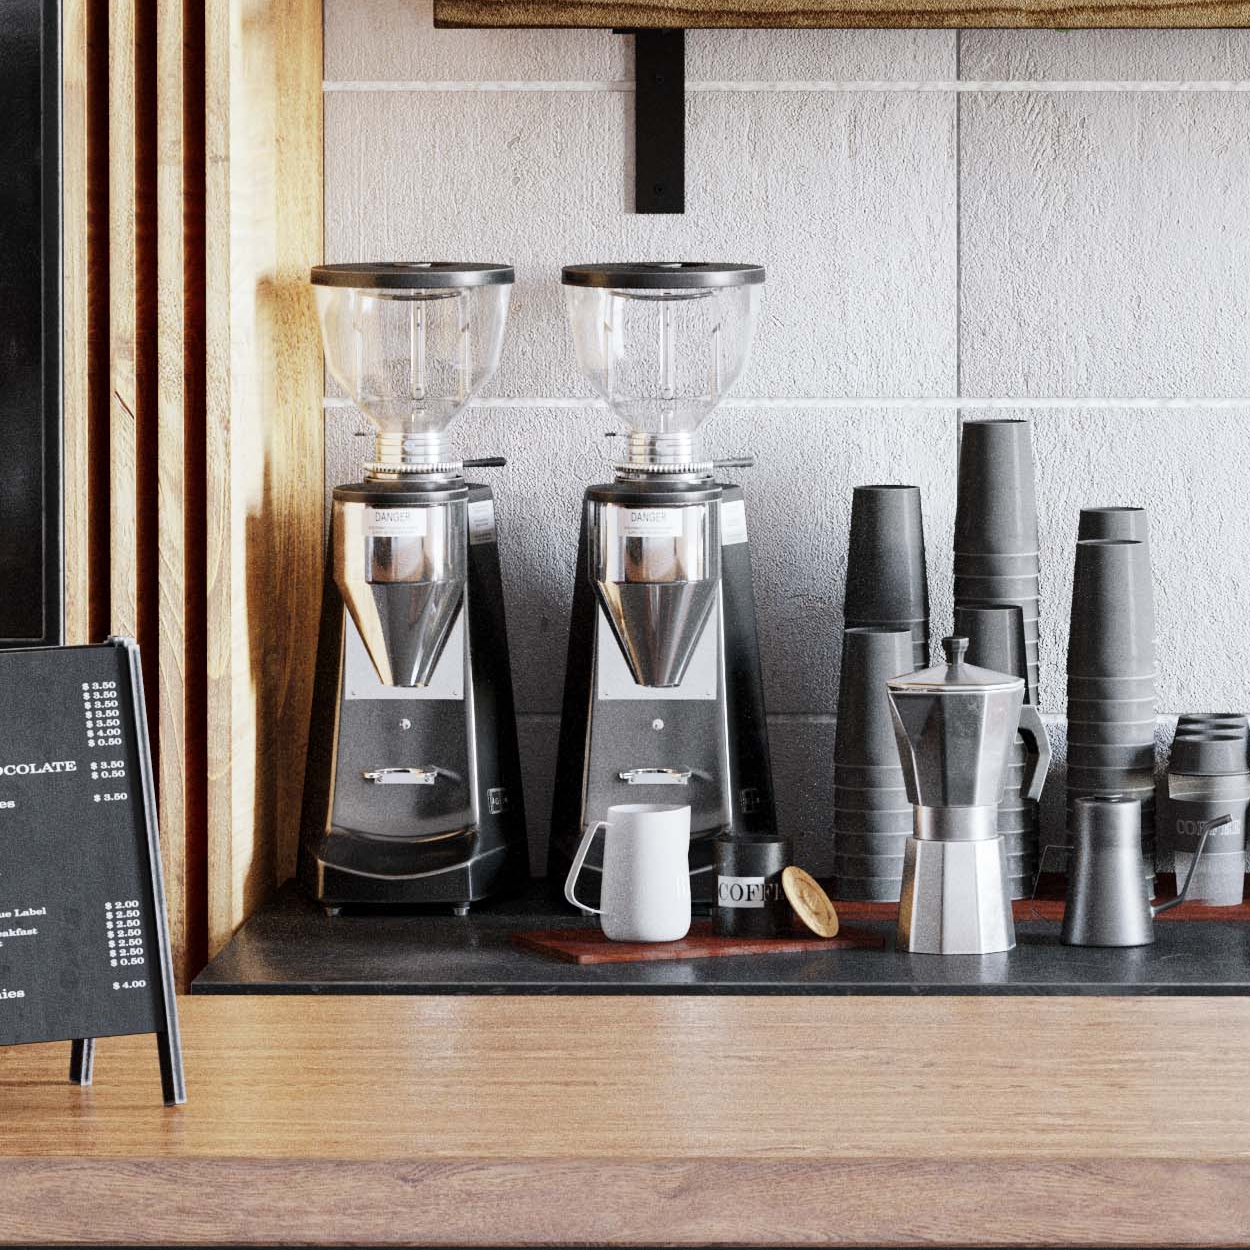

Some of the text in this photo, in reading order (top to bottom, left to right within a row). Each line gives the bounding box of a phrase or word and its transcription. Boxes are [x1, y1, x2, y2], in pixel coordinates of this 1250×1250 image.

[92, 681, 116, 690] 3.50
[93, 691, 117, 699] 3.50
[94, 700, 118, 708] 3.50
[95, 709, 119, 718] 3.50
[96, 719, 120, 727] 3.50
[97, 728, 121, 737] 4.00
[97, 737, 122, 746] 0.50
[0, 760, 77, 776] COLATE
[100, 760, 125, 769] 3.50
[101, 769, 126, 779] 0.50
[103, 792, 128, 802] 3.50
[115, 900, 139, 909] 2.00
[14, 907, 47, 918] Label
[115, 909, 140, 919] 2.50
[116, 919, 140, 928] 2.50
[117, 928, 141, 938] 2.50
[118, 938, 142, 947] 2.50
[119, 947, 144, 957] 2.50
[120, 957, 145, 966] 0.50
[122, 980, 146, 989] 4.00
[0, 988, 25, 1000] ies
